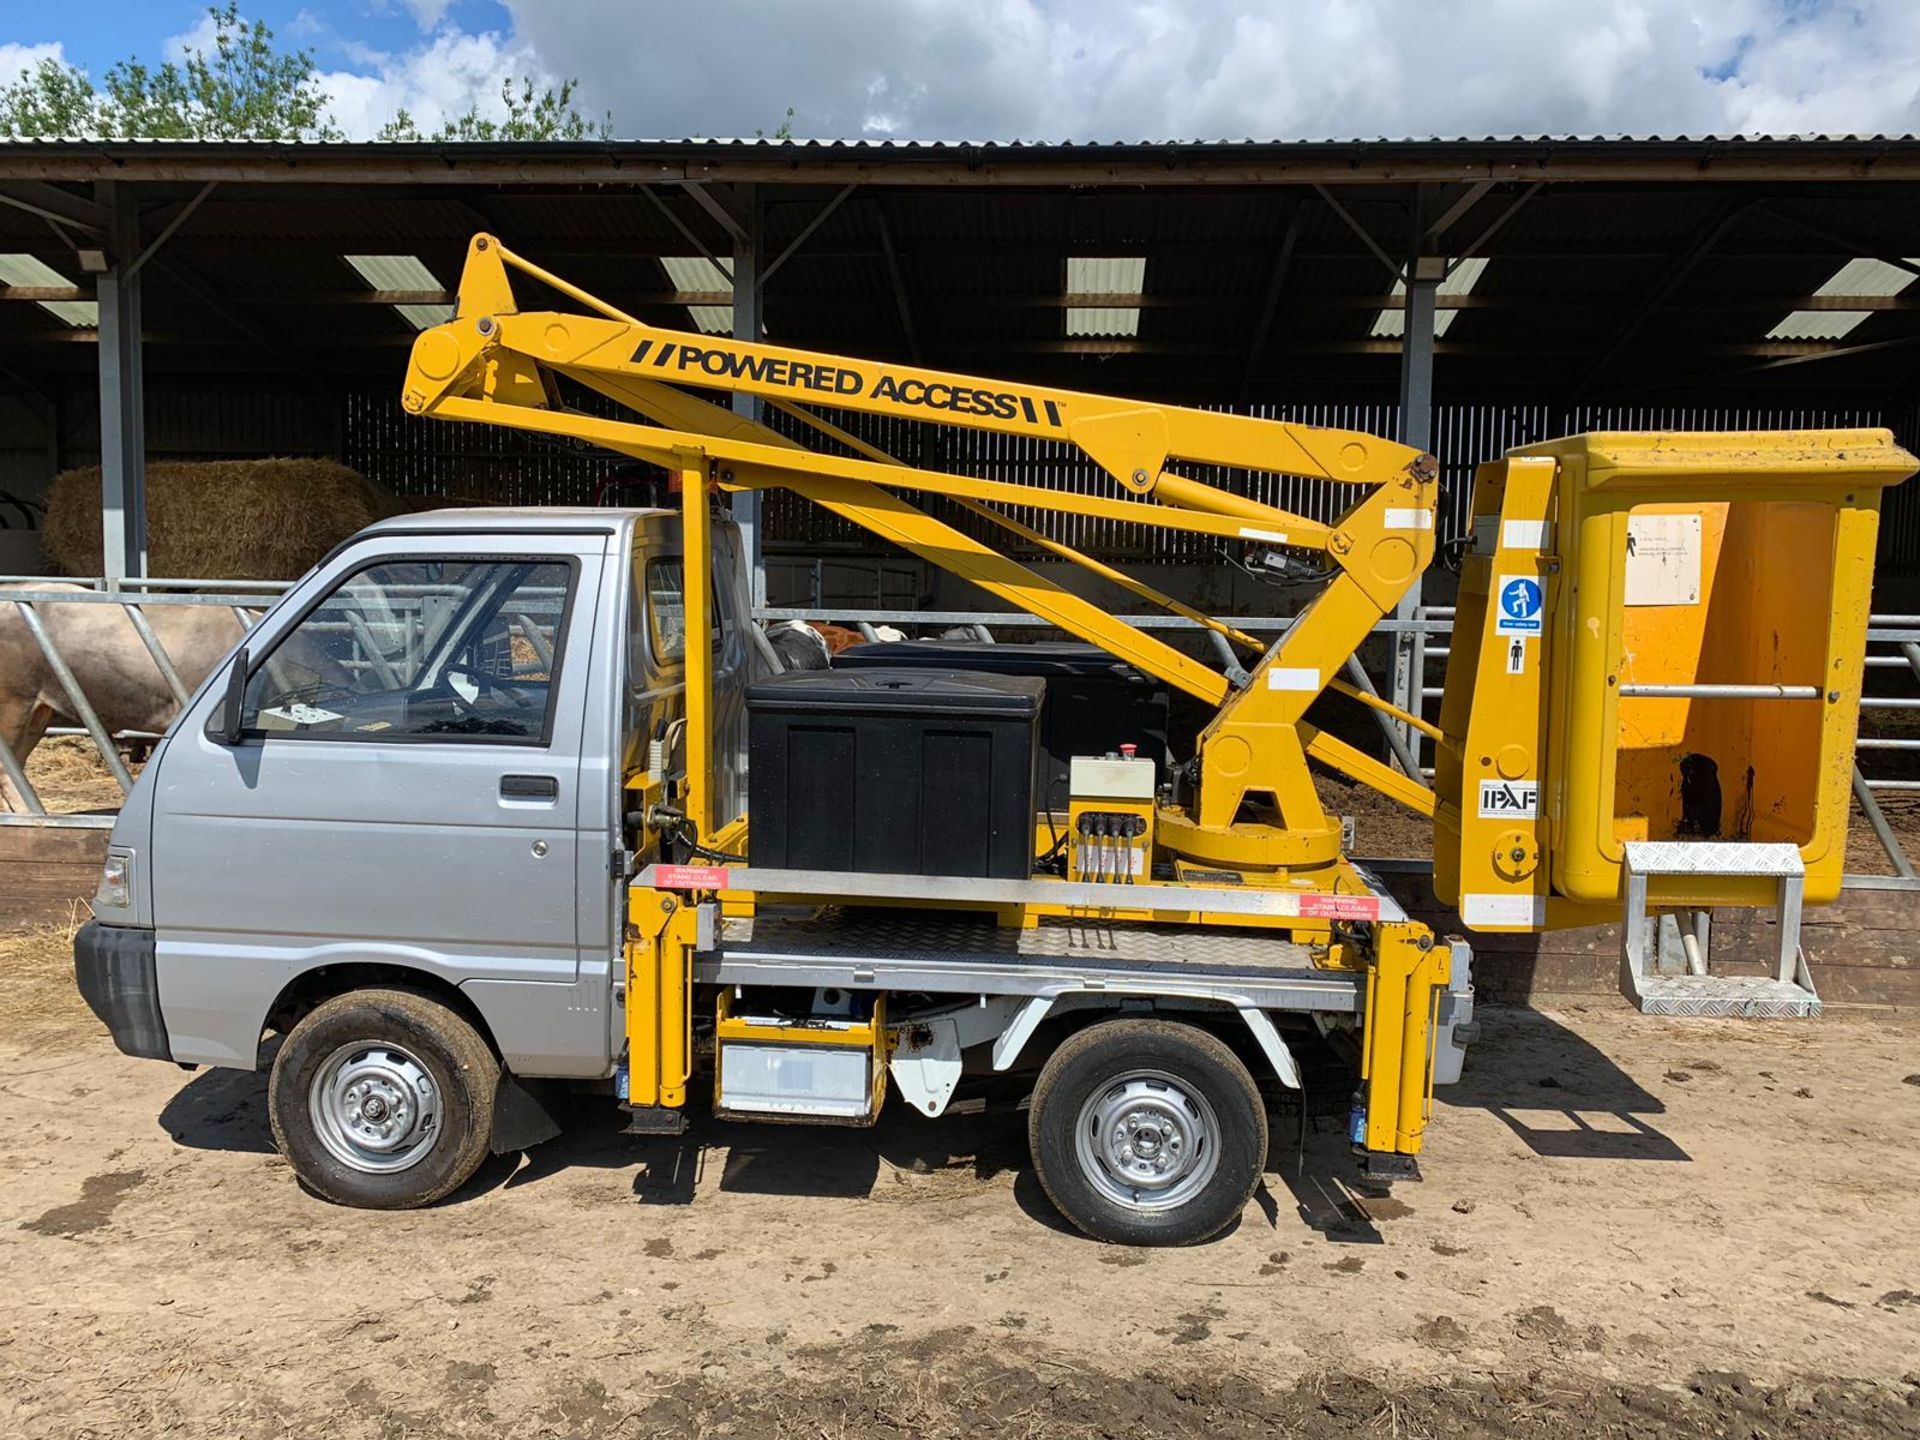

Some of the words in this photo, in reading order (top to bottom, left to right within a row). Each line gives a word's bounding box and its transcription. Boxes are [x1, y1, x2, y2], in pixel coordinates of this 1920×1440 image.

[678, 347, 863, 395] POWERED
[870, 374, 1018, 419] ACCESS
[1483, 782, 1537, 810] IPAF
